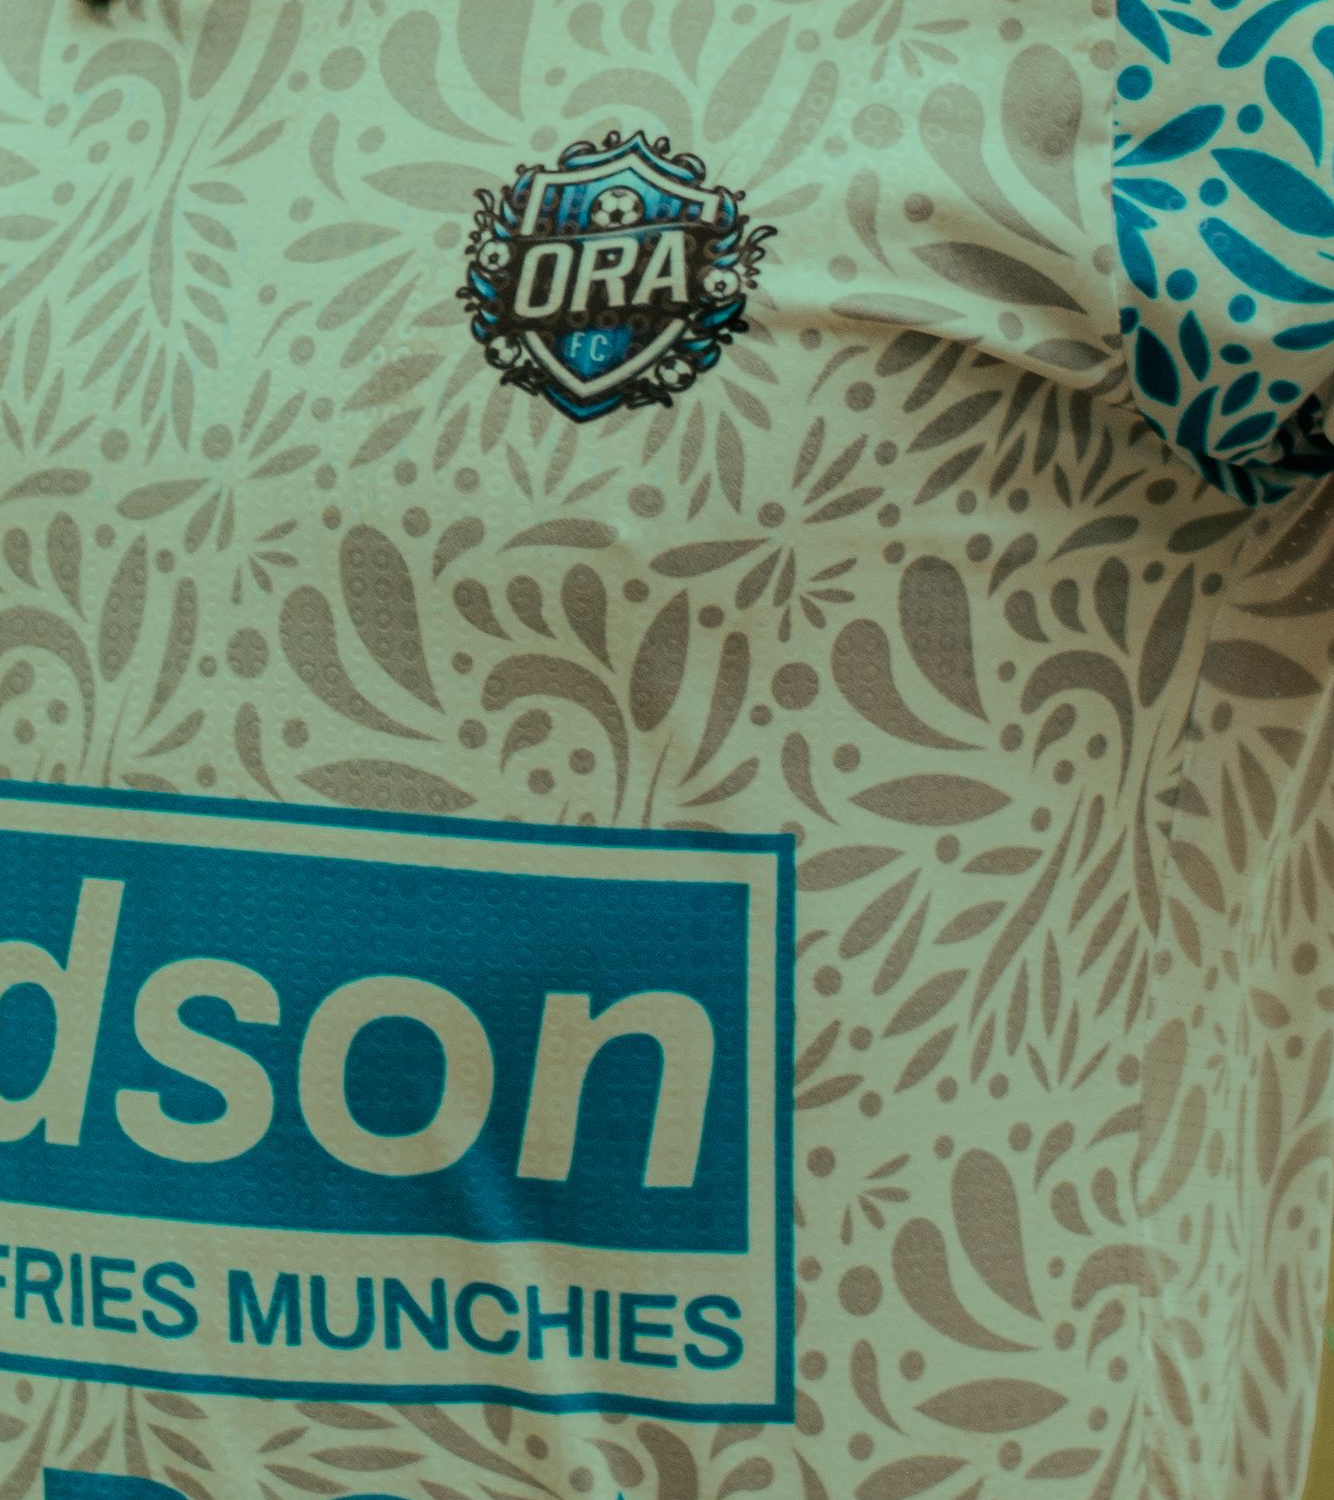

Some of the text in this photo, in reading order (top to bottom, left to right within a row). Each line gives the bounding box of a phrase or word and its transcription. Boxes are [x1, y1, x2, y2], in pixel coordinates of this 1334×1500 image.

[514, 230, 689, 319] ORA
[568, 331, 608, 362] FC
[227, 1269, 744, 1371] MUNCHIES
